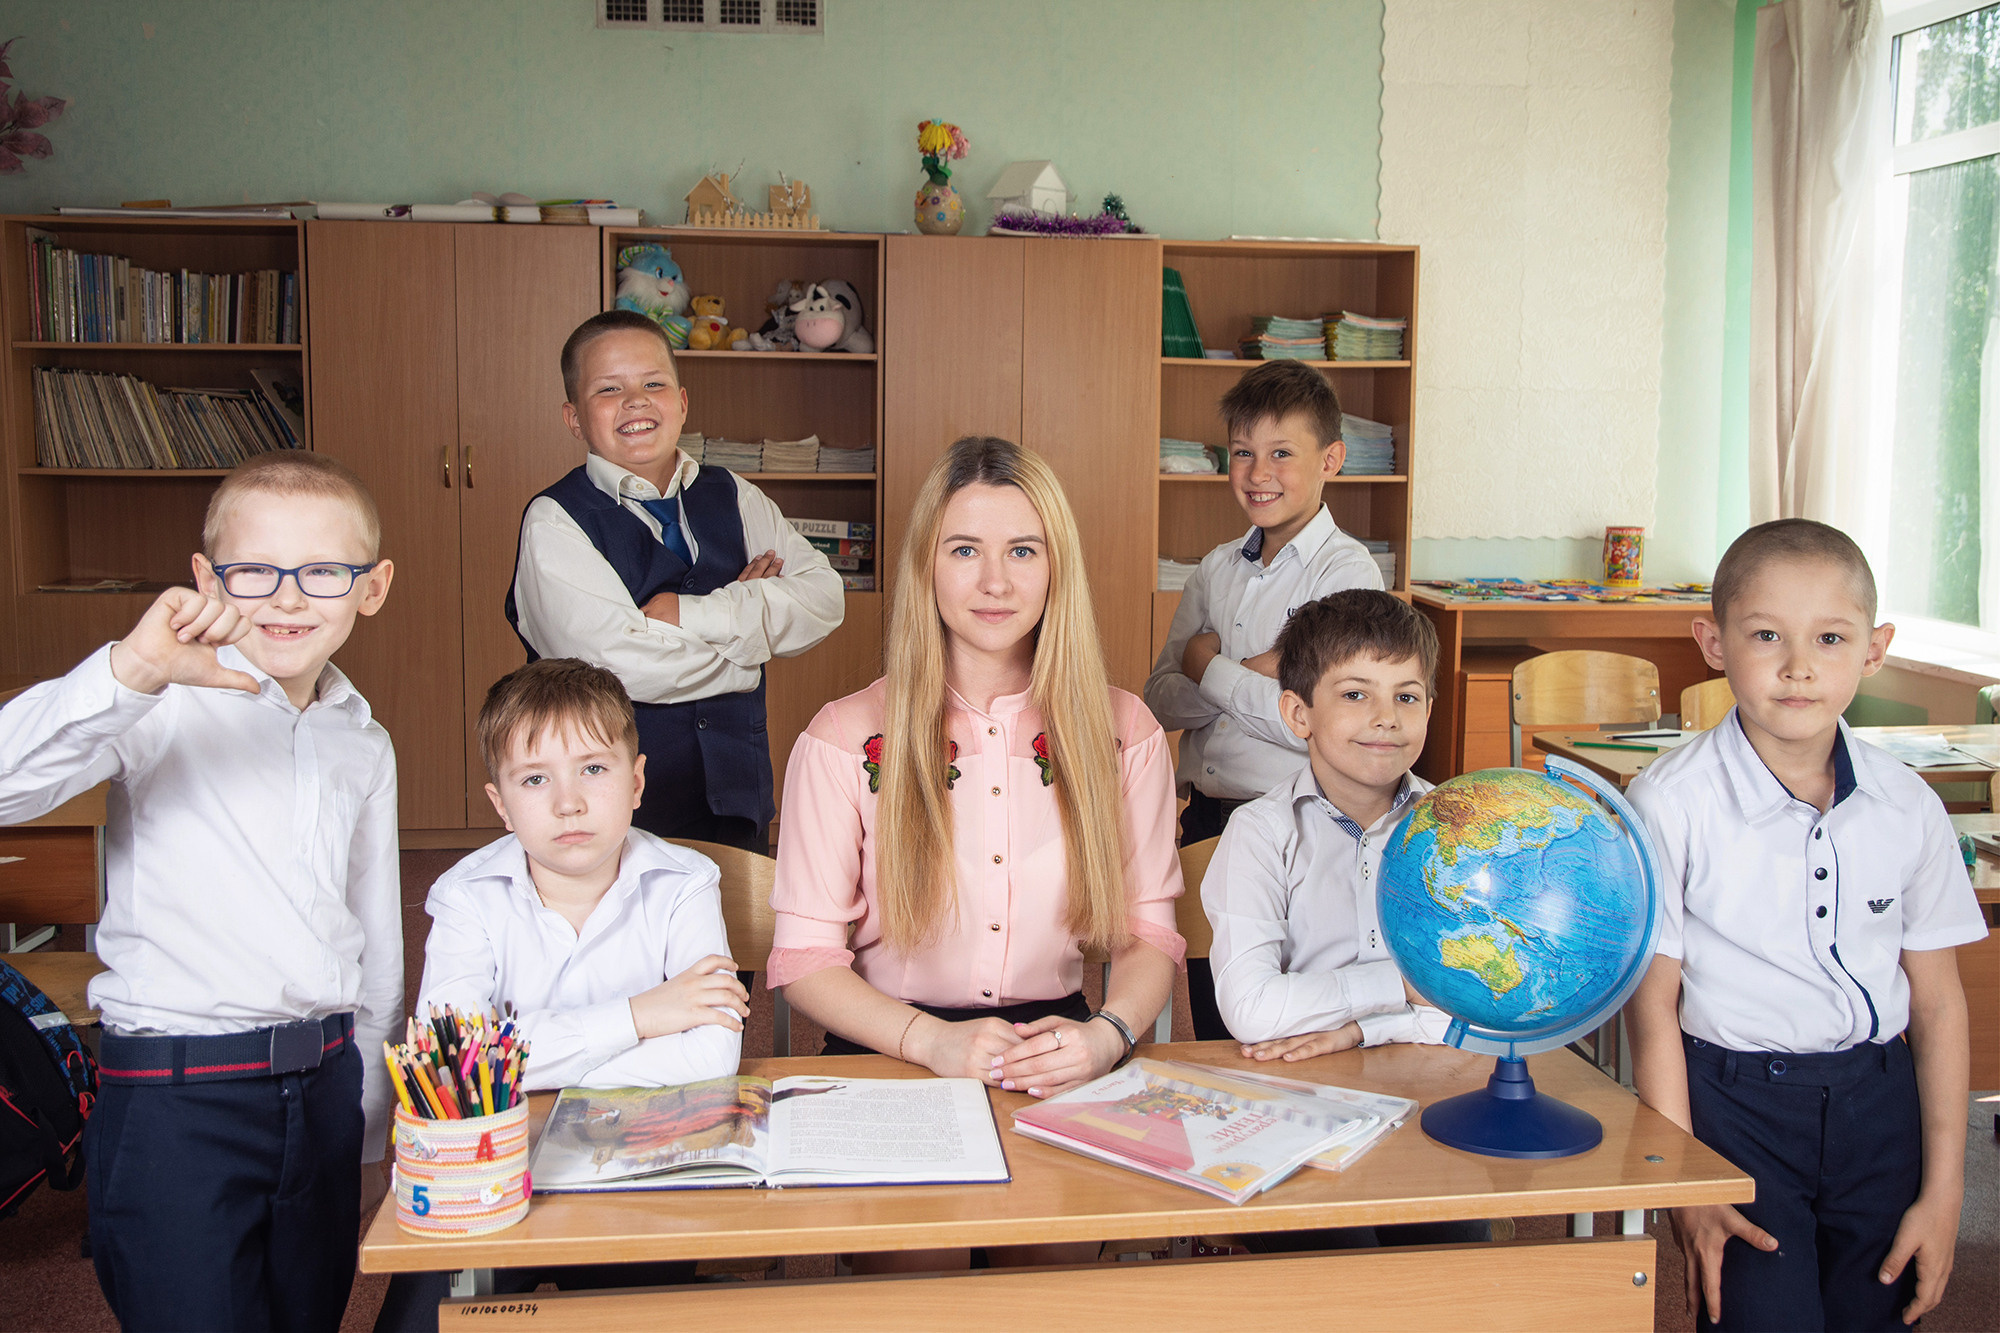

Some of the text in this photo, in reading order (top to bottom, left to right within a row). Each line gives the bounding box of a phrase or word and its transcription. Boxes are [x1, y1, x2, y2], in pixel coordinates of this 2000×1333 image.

[802, 522, 837, 534] PUZZLE
[1211, 1117, 1277, 1154] ературное
[412, 1185, 430, 1216] 5
